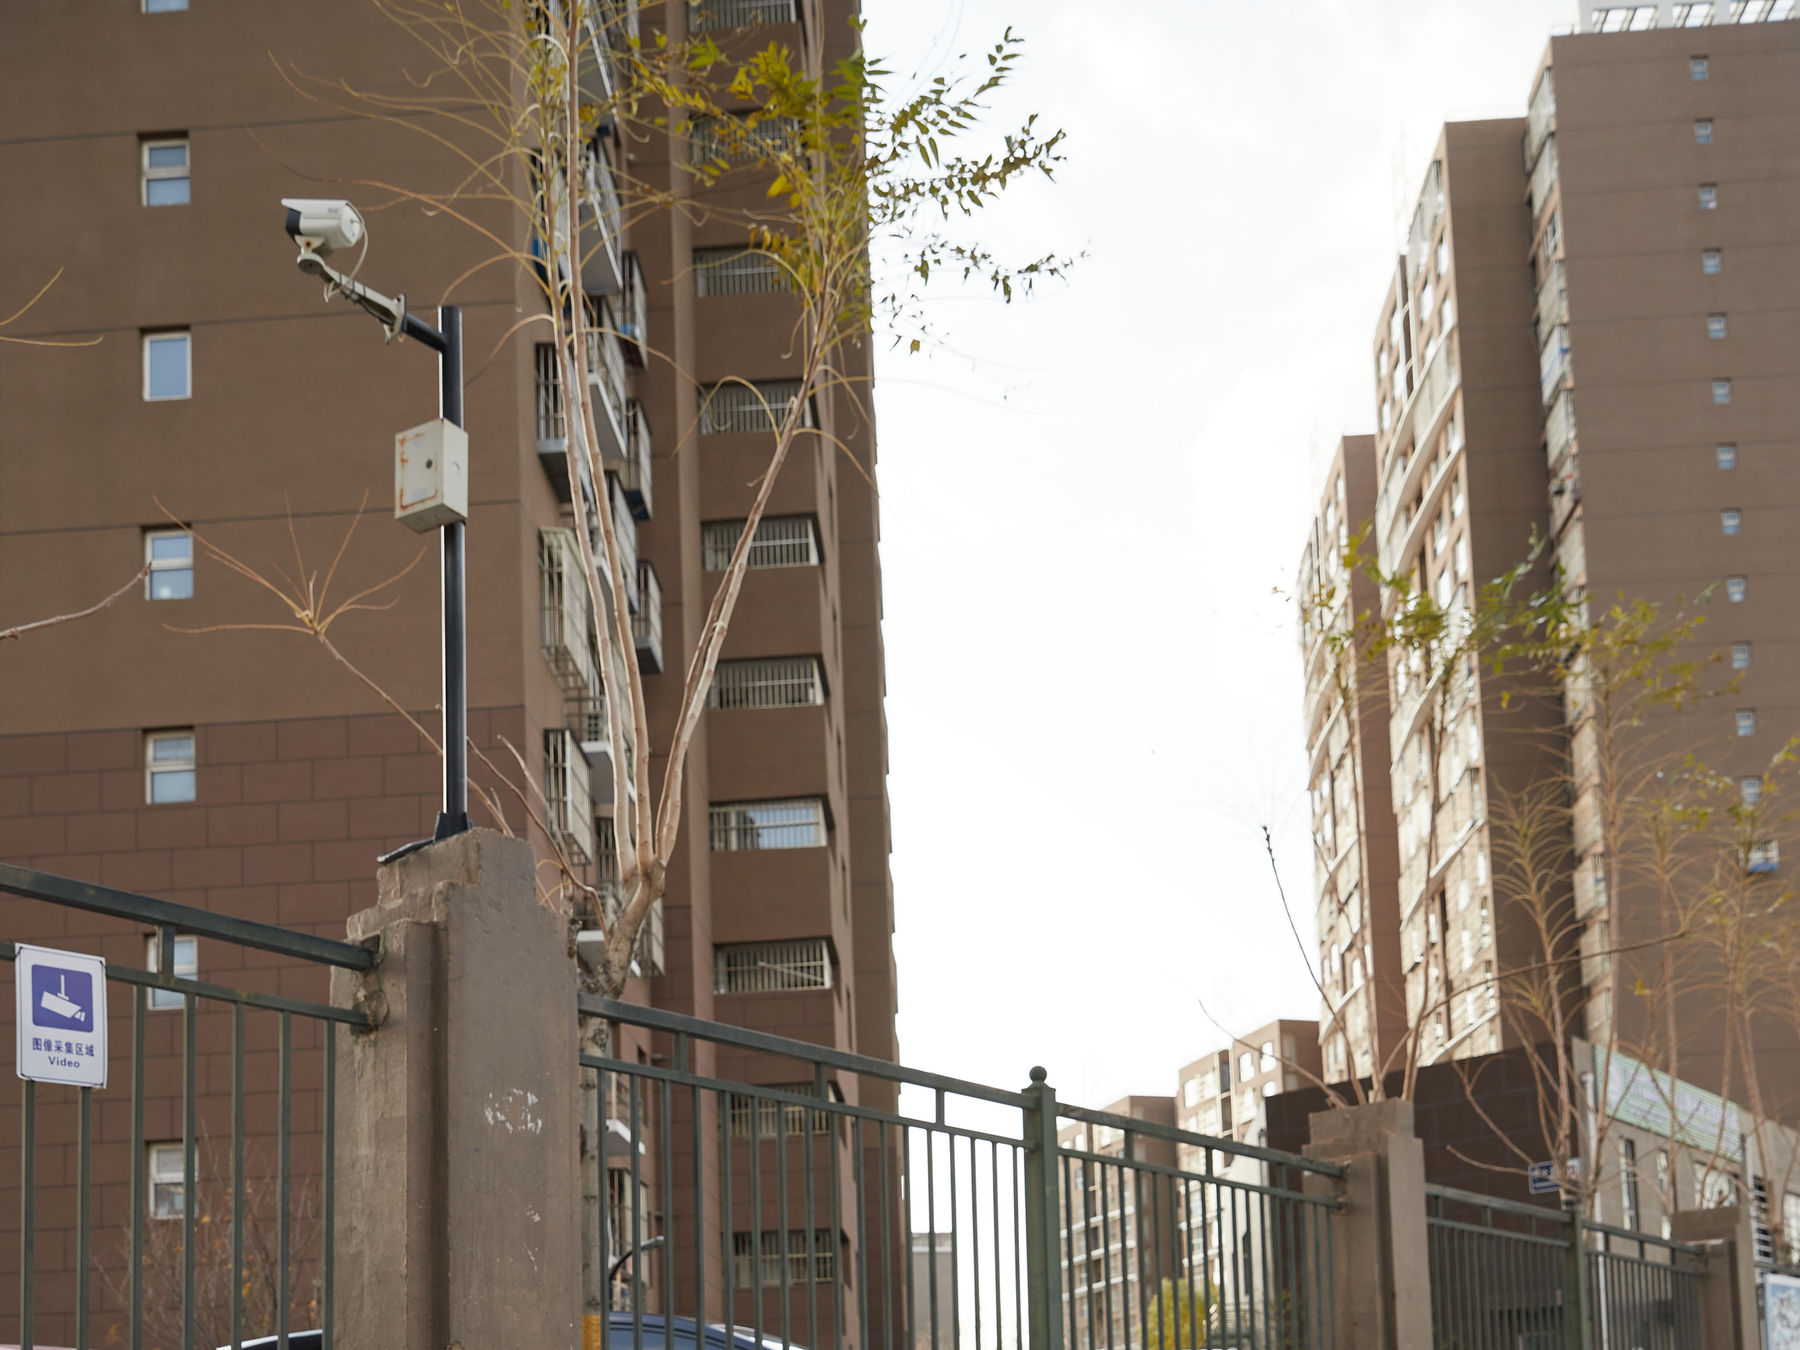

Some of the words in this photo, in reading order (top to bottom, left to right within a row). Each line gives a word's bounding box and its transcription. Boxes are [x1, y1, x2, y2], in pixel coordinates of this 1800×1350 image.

[32, 1037, 95, 1057] 图像采集区域
[48, 1055, 80, 1068] Video
